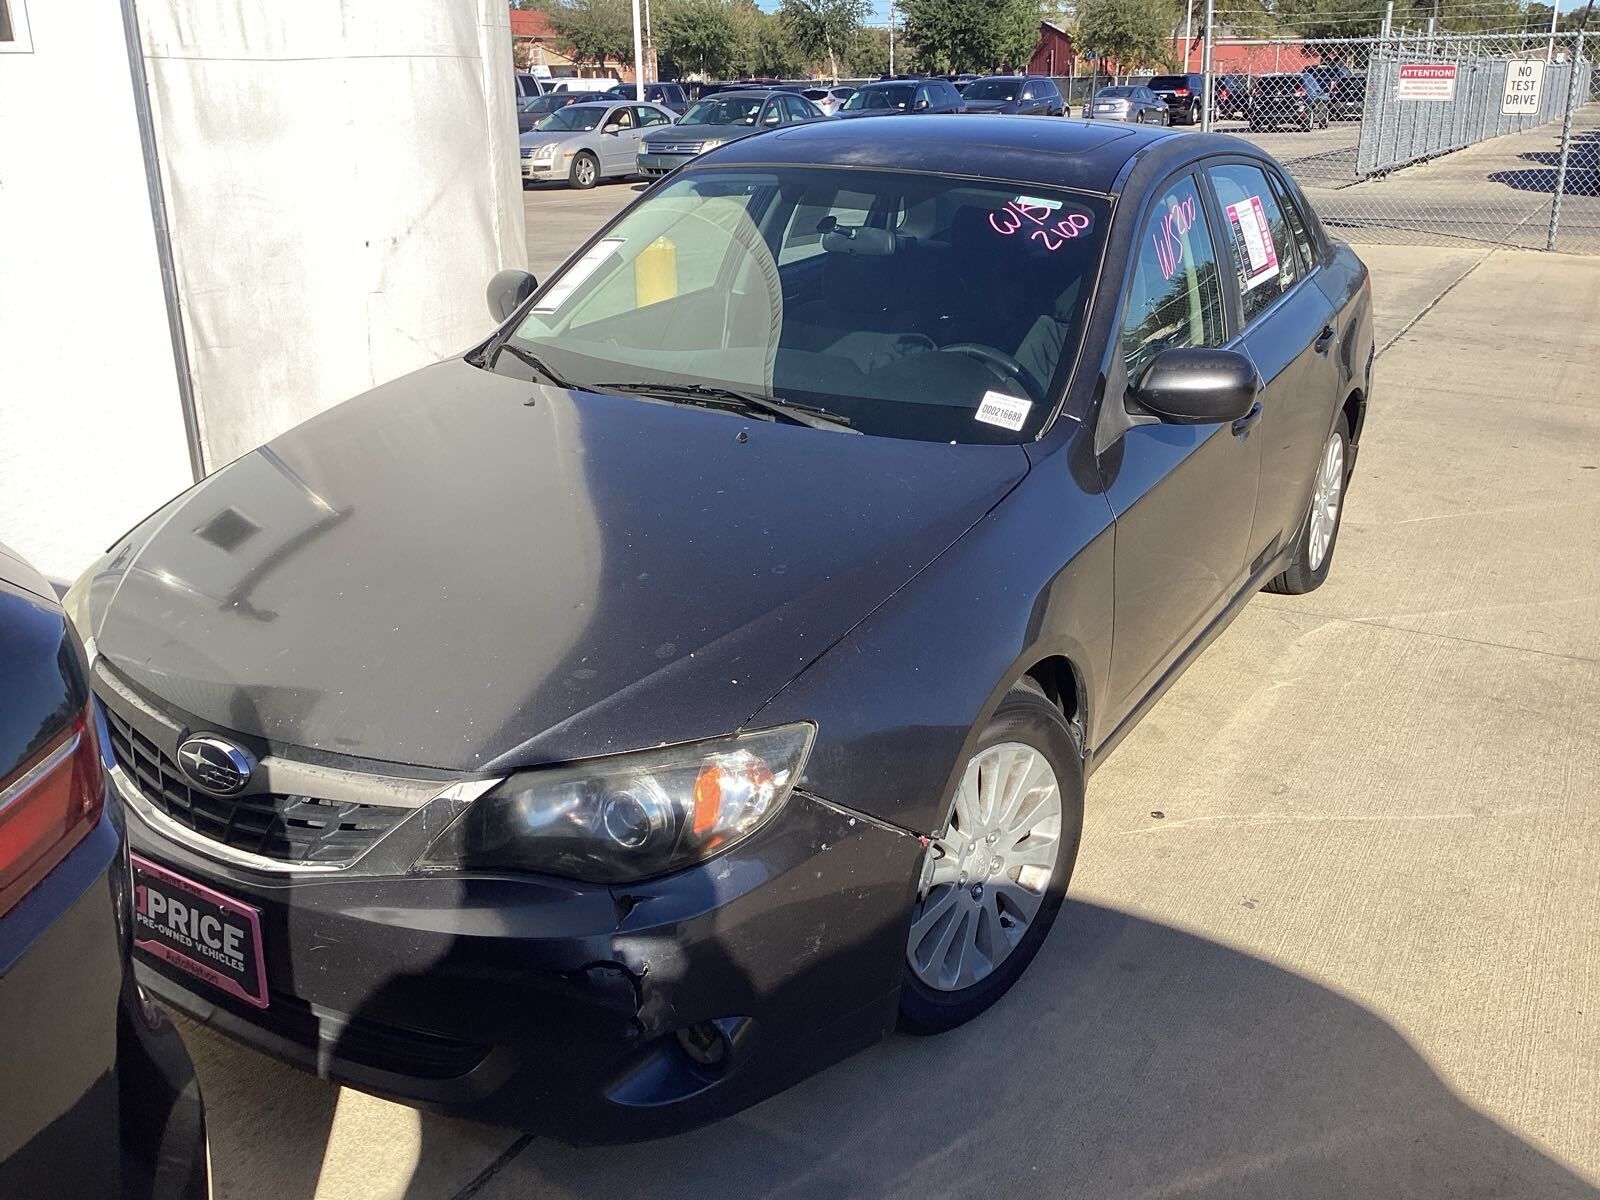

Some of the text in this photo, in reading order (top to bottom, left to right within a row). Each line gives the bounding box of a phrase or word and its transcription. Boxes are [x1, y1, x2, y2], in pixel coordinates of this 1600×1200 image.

[1401, 69, 1455, 77] ATTENTION!
[1518, 66, 1532, 77] NO
[1511, 80, 1536, 91] TEST
[1505, 95, 1536, 105] DRIVE
[982, 404, 1022, 422] 000216688
[137, 912, 245, 973] PRE-OWNED VEHICLES
